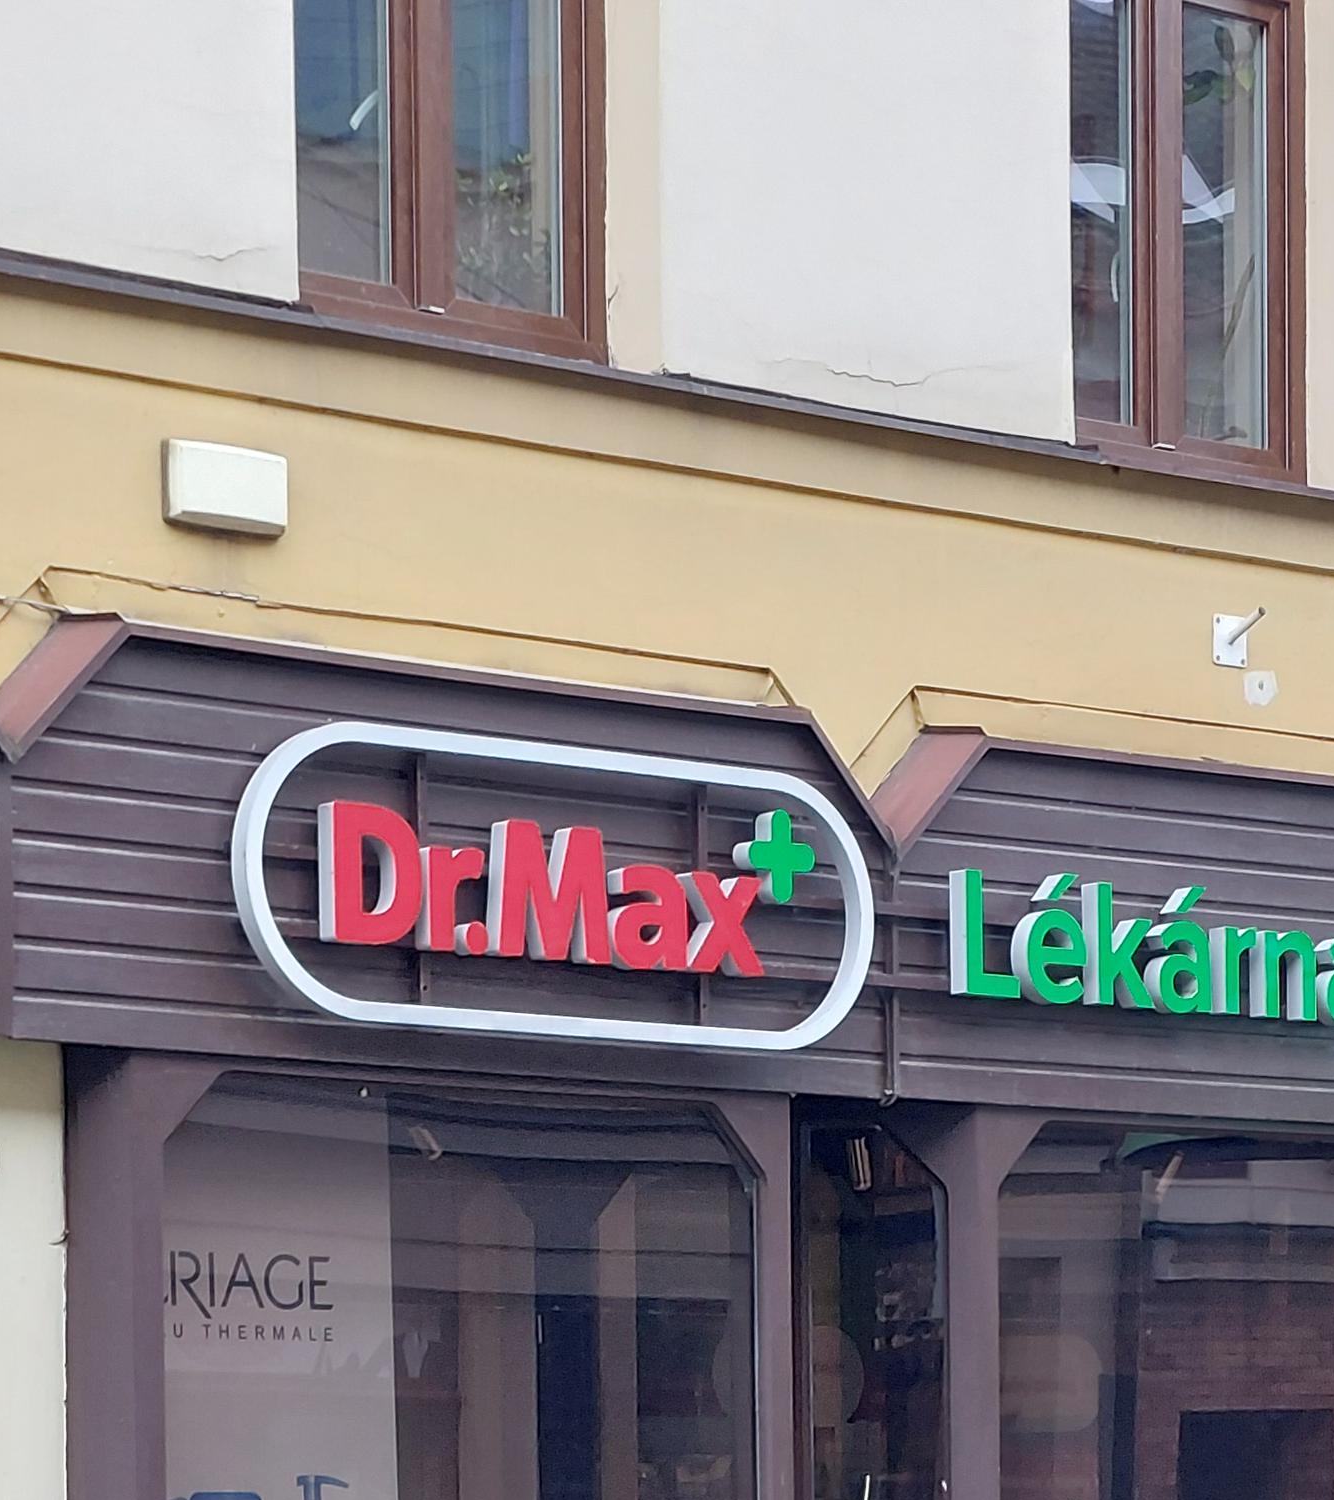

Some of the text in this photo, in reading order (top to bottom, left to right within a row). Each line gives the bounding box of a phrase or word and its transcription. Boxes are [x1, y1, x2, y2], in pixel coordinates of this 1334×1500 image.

[315, 799, 766, 979] Dr.Max
[164, 1250, 334, 1319] RIAGE
[202, 1323, 334, 1342] THERMALE
